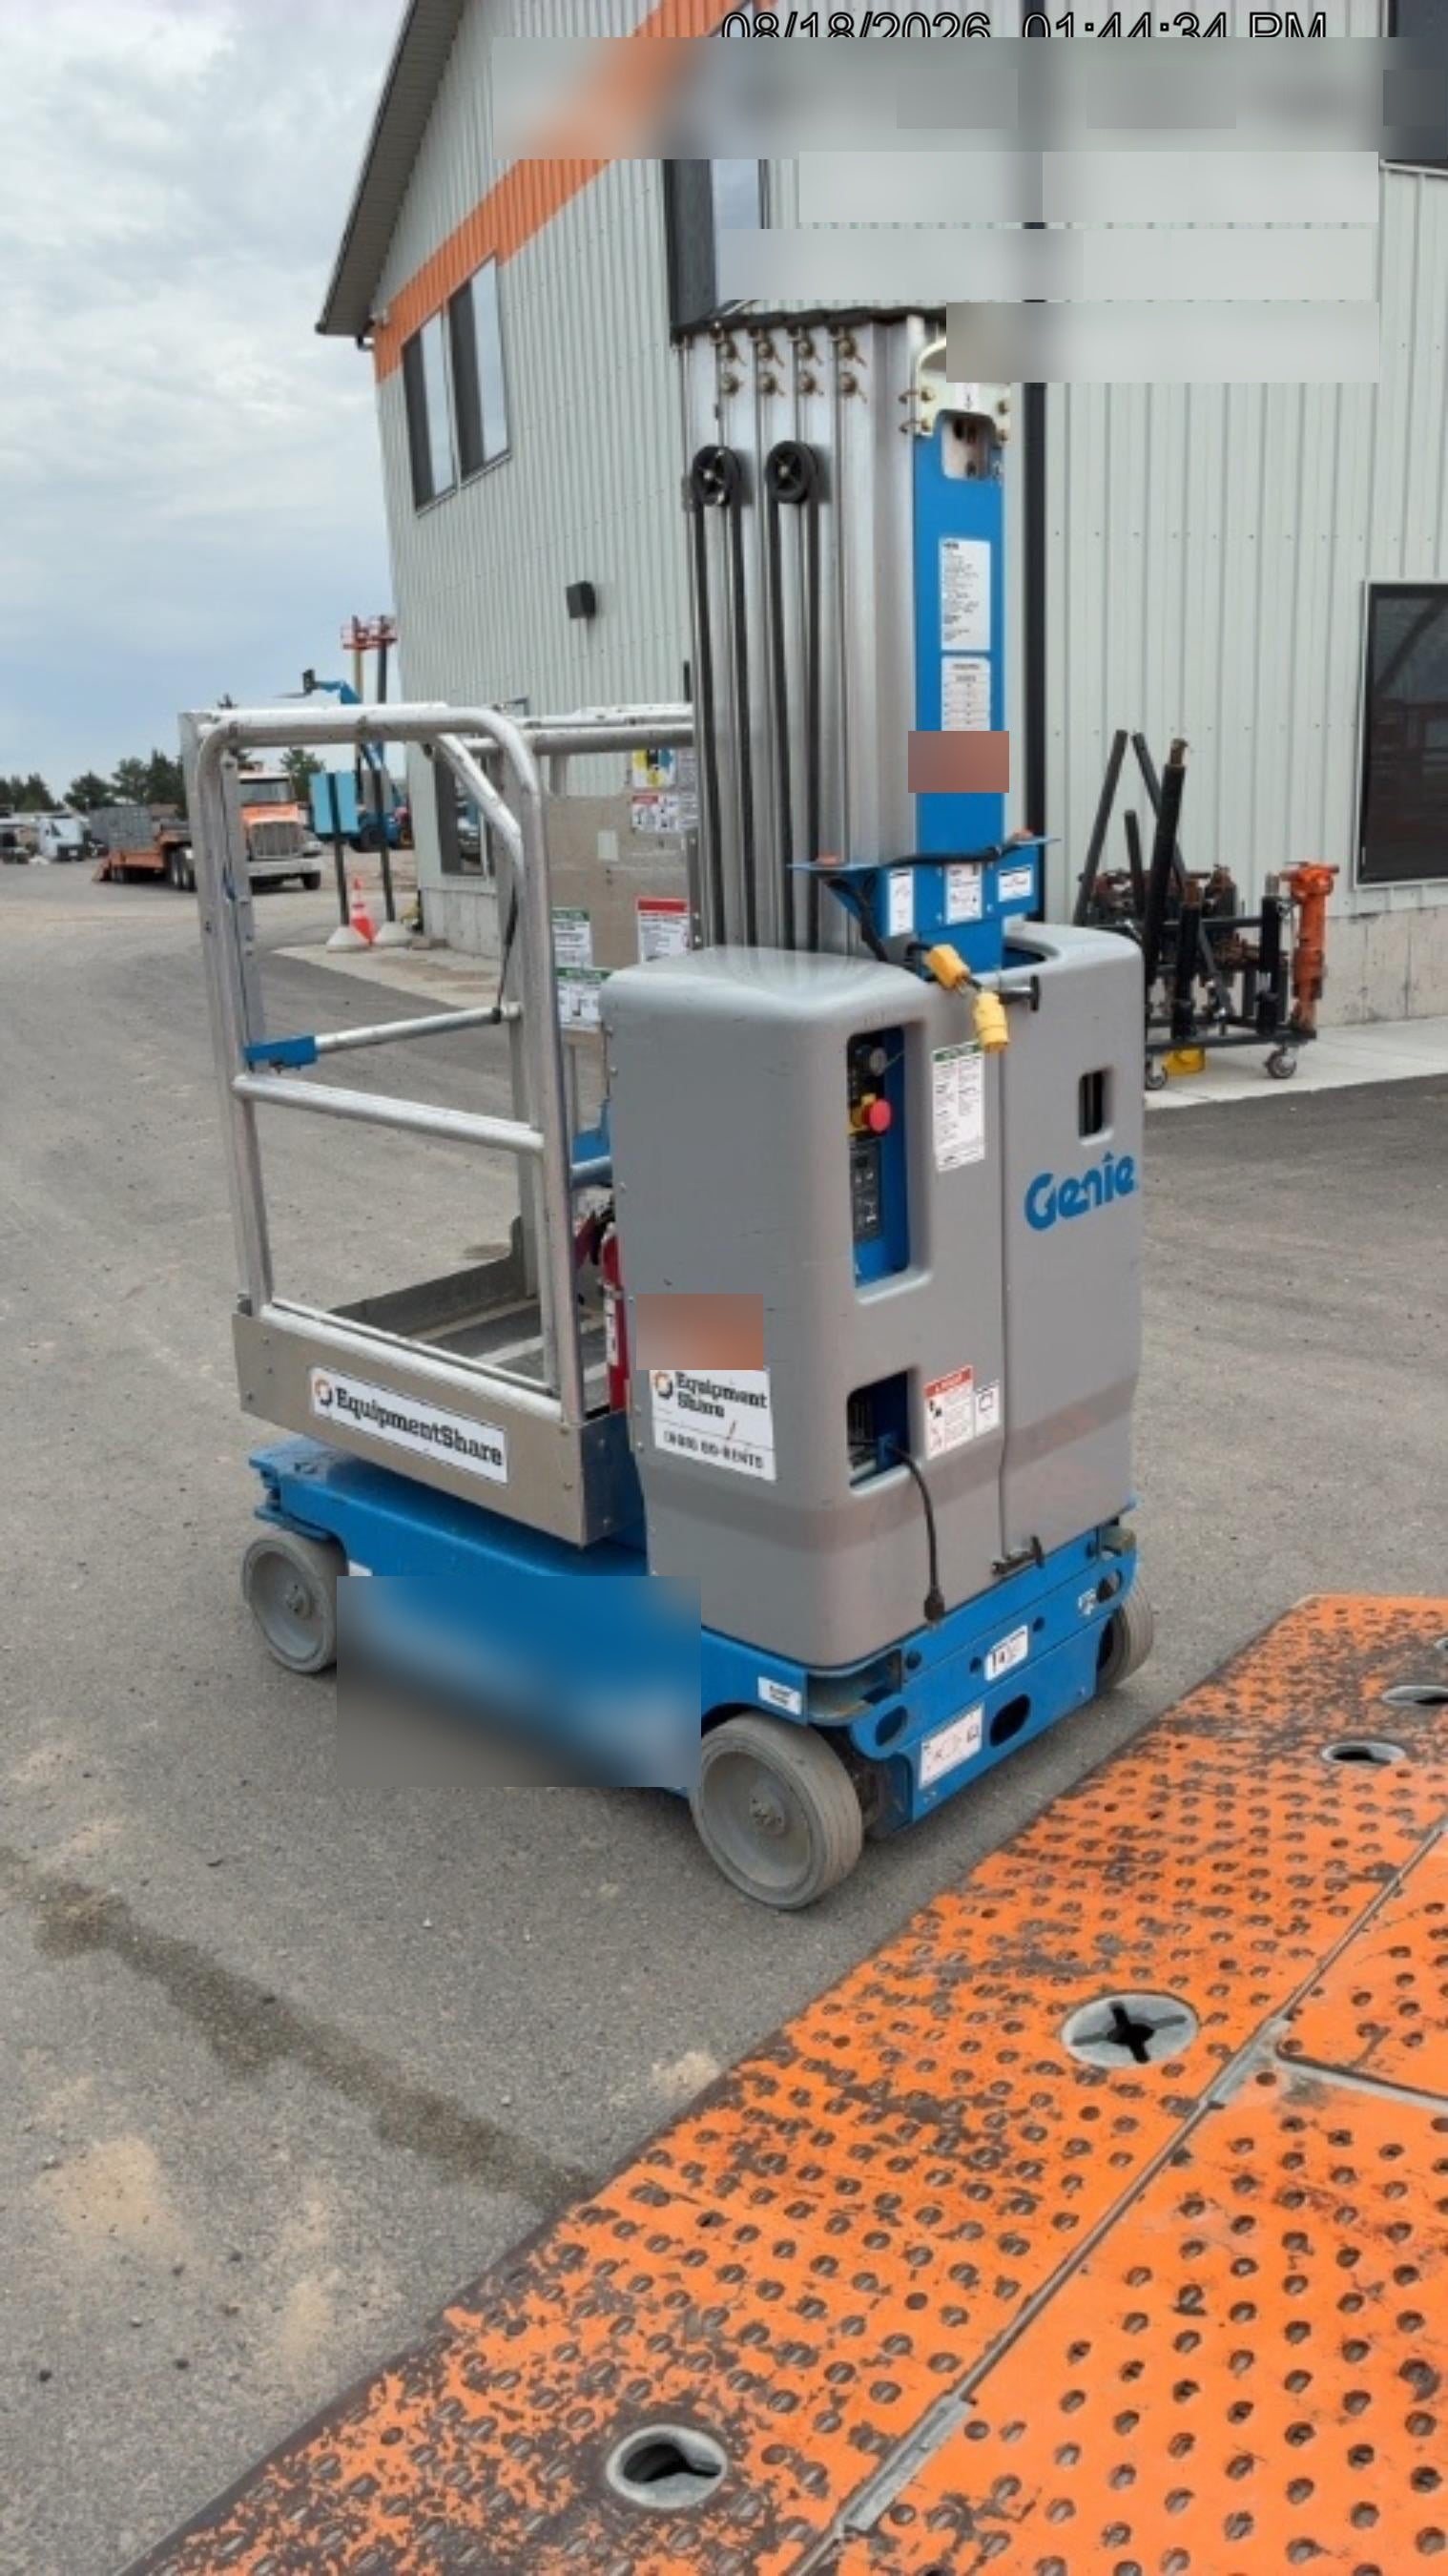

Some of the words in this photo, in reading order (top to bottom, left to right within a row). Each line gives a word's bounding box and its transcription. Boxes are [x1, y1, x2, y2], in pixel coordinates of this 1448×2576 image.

[1024, 1151, 1135, 1231] Genie
[675, 1371, 767, 1409] Equipment
[678, 1391, 725, 1419] Share
[336, 1387, 502, 1465] EquipmentShare
